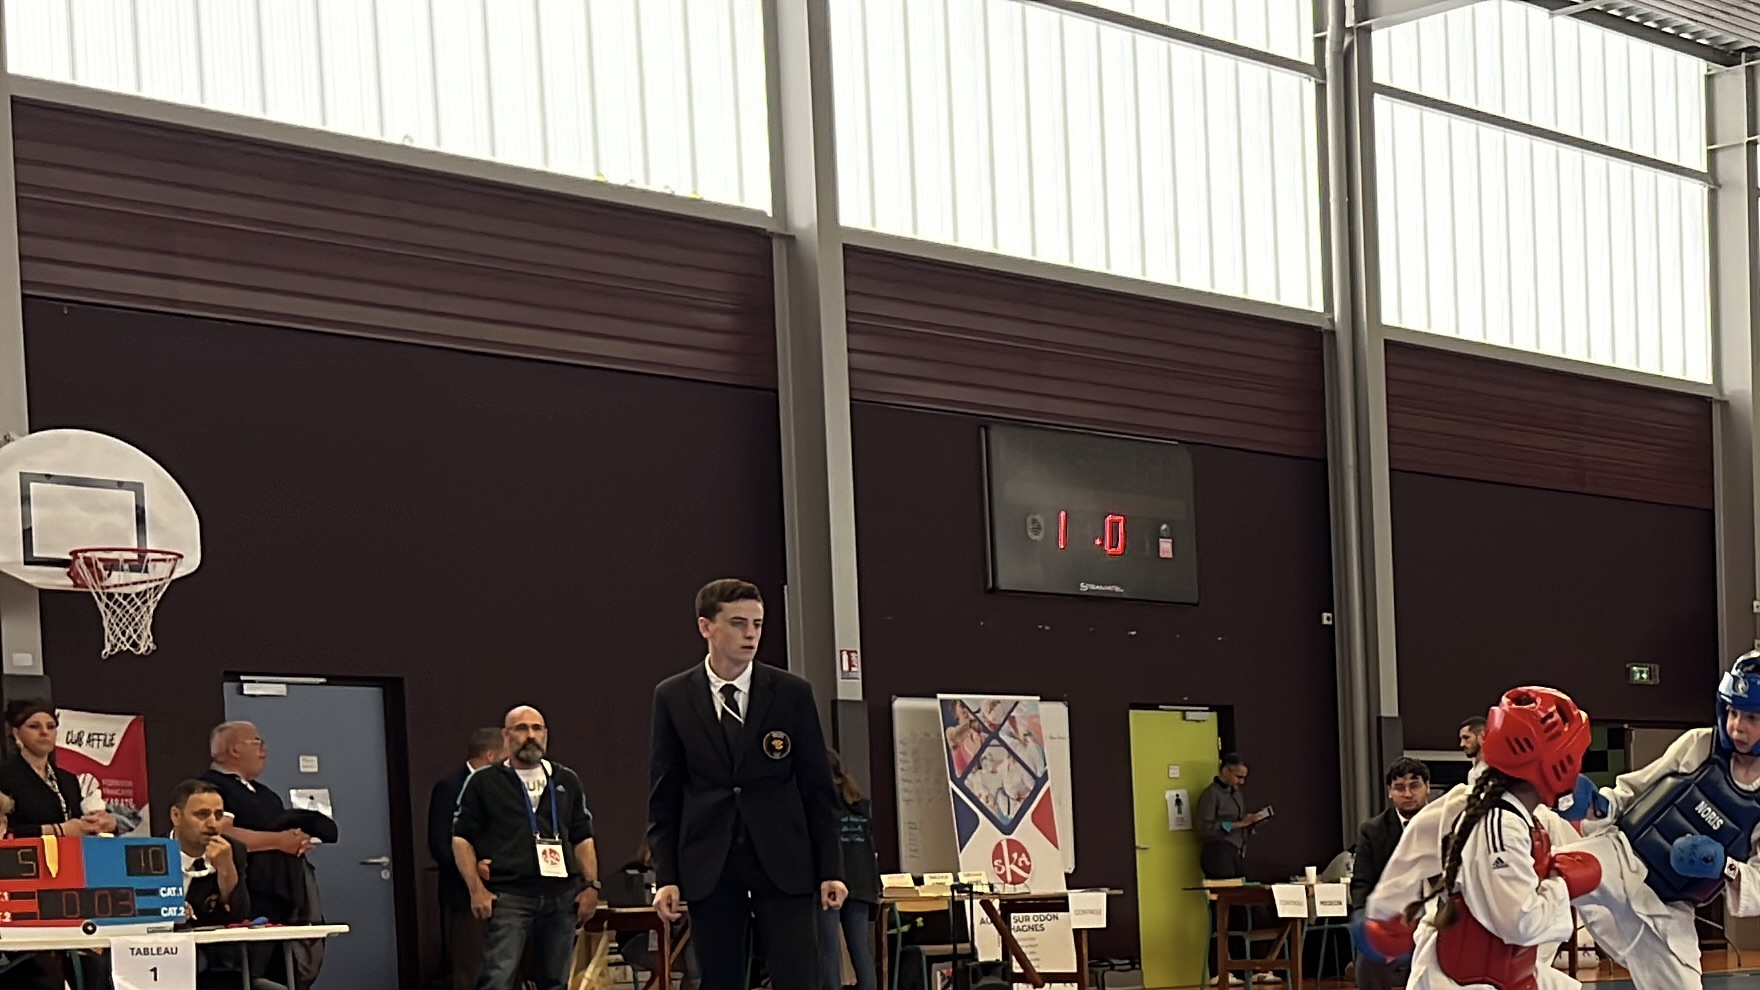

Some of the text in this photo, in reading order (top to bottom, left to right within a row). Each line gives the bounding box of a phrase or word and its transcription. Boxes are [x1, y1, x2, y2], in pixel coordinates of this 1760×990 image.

[1694, 800, 1724, 830] NORIS
[17, 848, 37, 877] 5
[140, 846, 166, 875] 10
[159, 886, 183, 897] CAT.1
[160, 907, 186, 917] CAT.2
[1012, 914, 1031, 924] SUR
[1032, 913, 1059, 923] ODON
[129, 946, 179, 957] TABLEAU
[149, 966, 158, 982] 1
